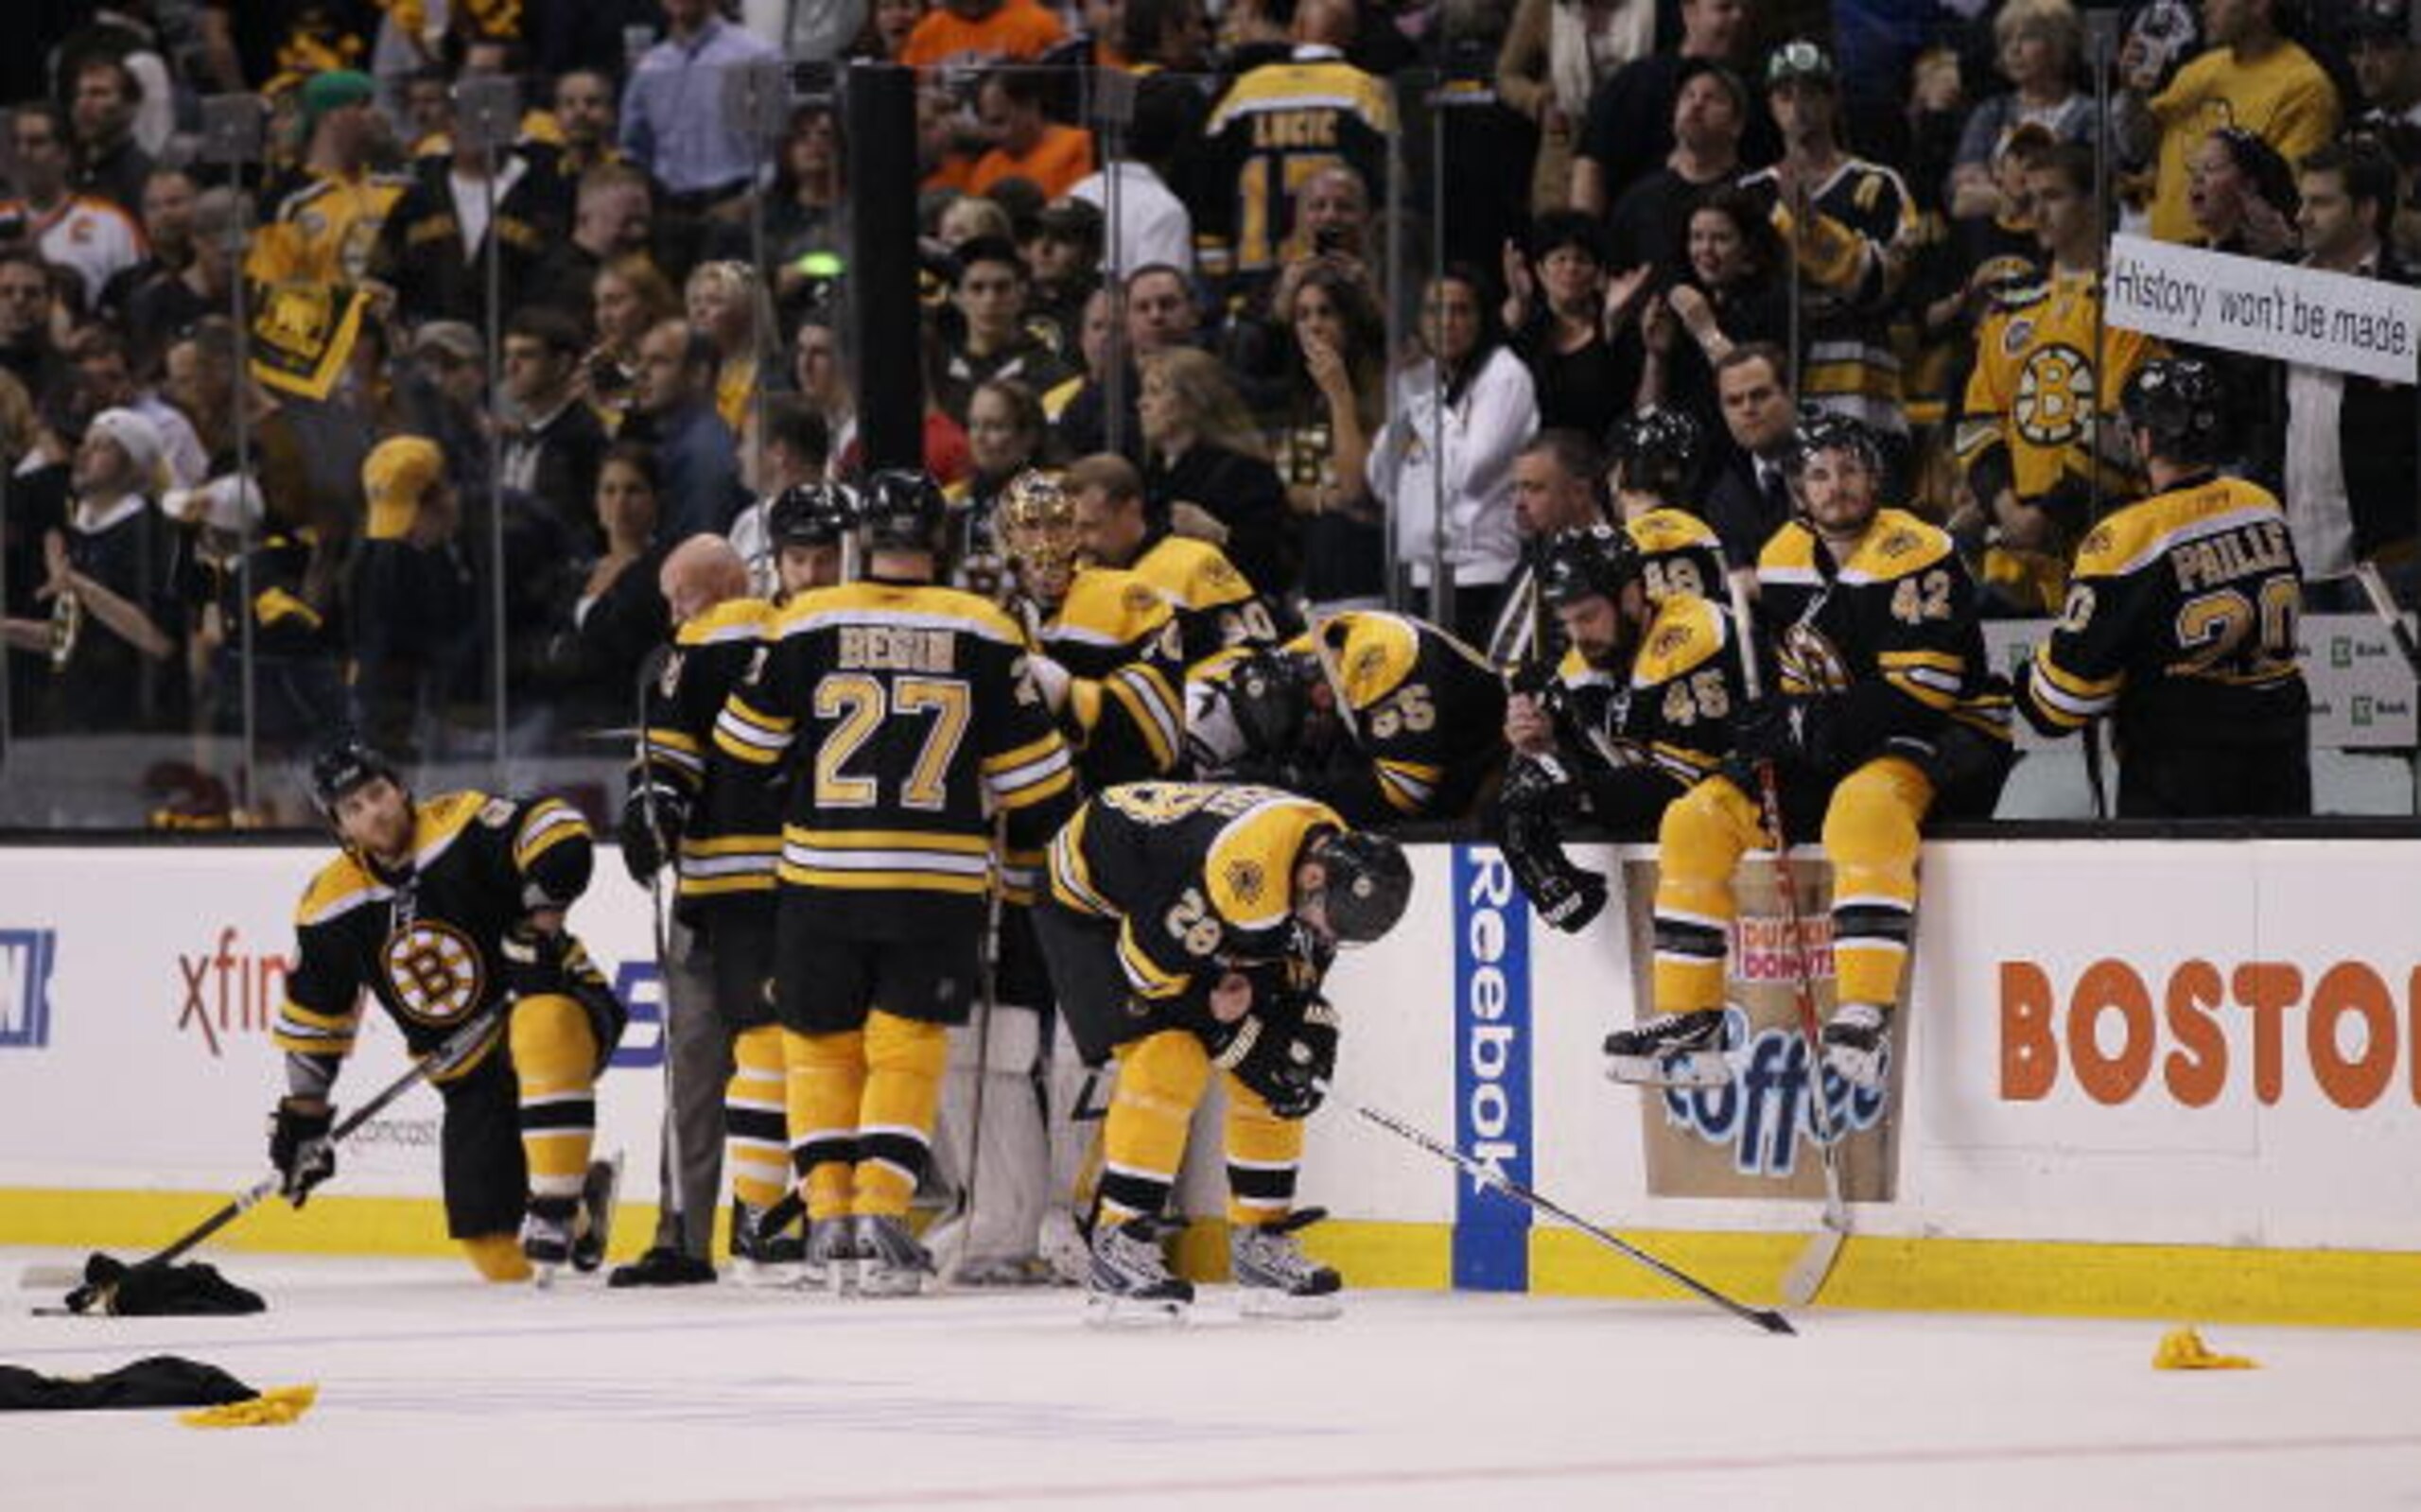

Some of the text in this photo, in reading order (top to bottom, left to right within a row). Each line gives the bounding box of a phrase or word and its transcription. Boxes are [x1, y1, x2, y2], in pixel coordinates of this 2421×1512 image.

[2114, 255, 2414, 356] History won't be made.
[1891, 570, 1952, 625] 42
[1663, 669, 1730, 727] 45
[814, 674, 971, 811] 27
[1164, 887, 1224, 956] 28
[1469, 846, 1517, 1194] Reebok
